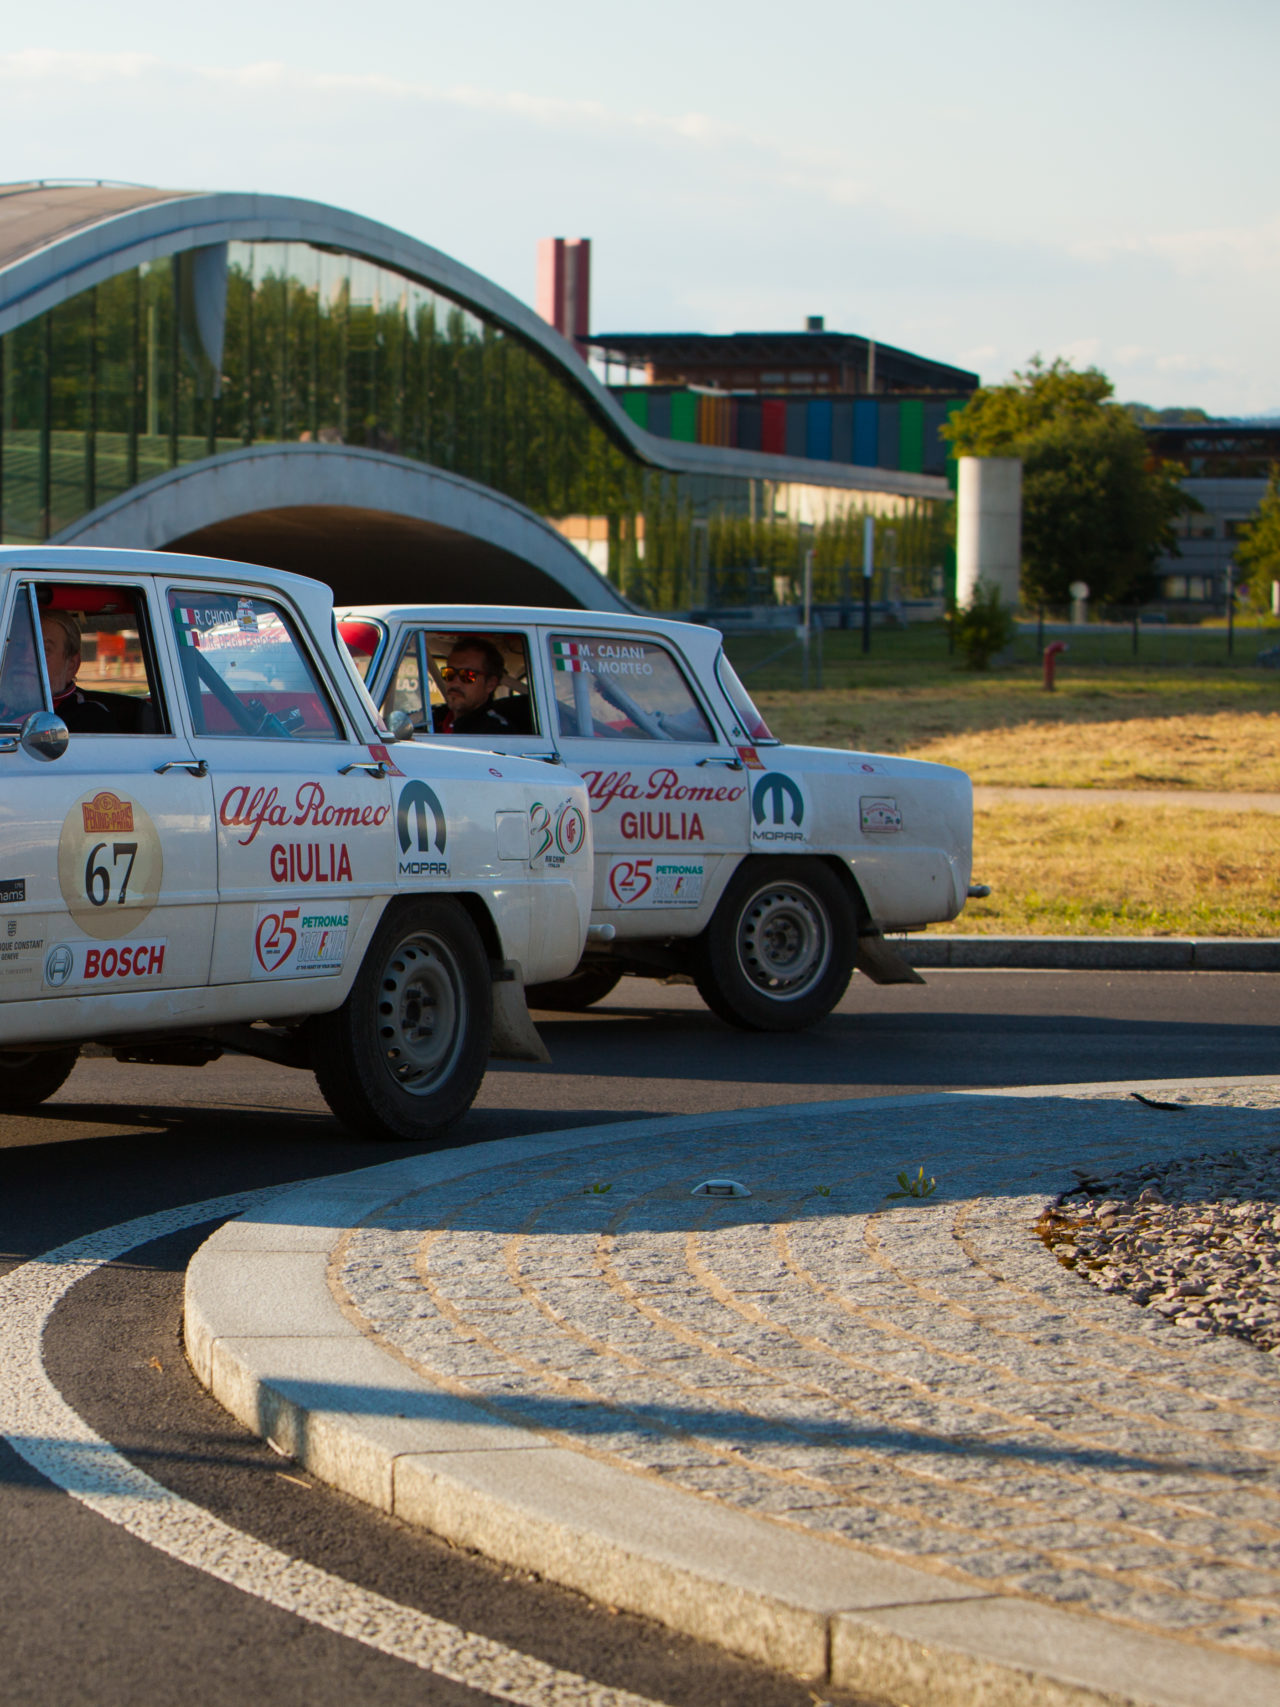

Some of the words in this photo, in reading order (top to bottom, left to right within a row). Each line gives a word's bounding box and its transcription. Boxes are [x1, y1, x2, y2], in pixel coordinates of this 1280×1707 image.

[194, 609, 205, 625] R.
[205, 609, 234, 626] CHIODI
[578, 644, 594, 657] M.
[597, 645, 644, 659] CAJANI
[581, 660, 594, 673] A.
[598, 662, 653, 676] MORTEO
[646, 768, 746, 801] Romeo
[219, 785, 294, 846] Alfa
[293, 781, 391, 826] Romeo
[621, 811, 705, 840] GIULIA
[753, 831, 804, 841] MOPAR
[270, 843, 353, 883] GIULIA
[399, 862, 447, 875] MOPAR
[656, 865, 704, 874] PETRONAS
[85, 842, 138, 906] 67
[302, 915, 349, 928] PETRONAS
[14, 939, 44, 950] CONSTANT
[84, 945, 165, 979] BOSCH
